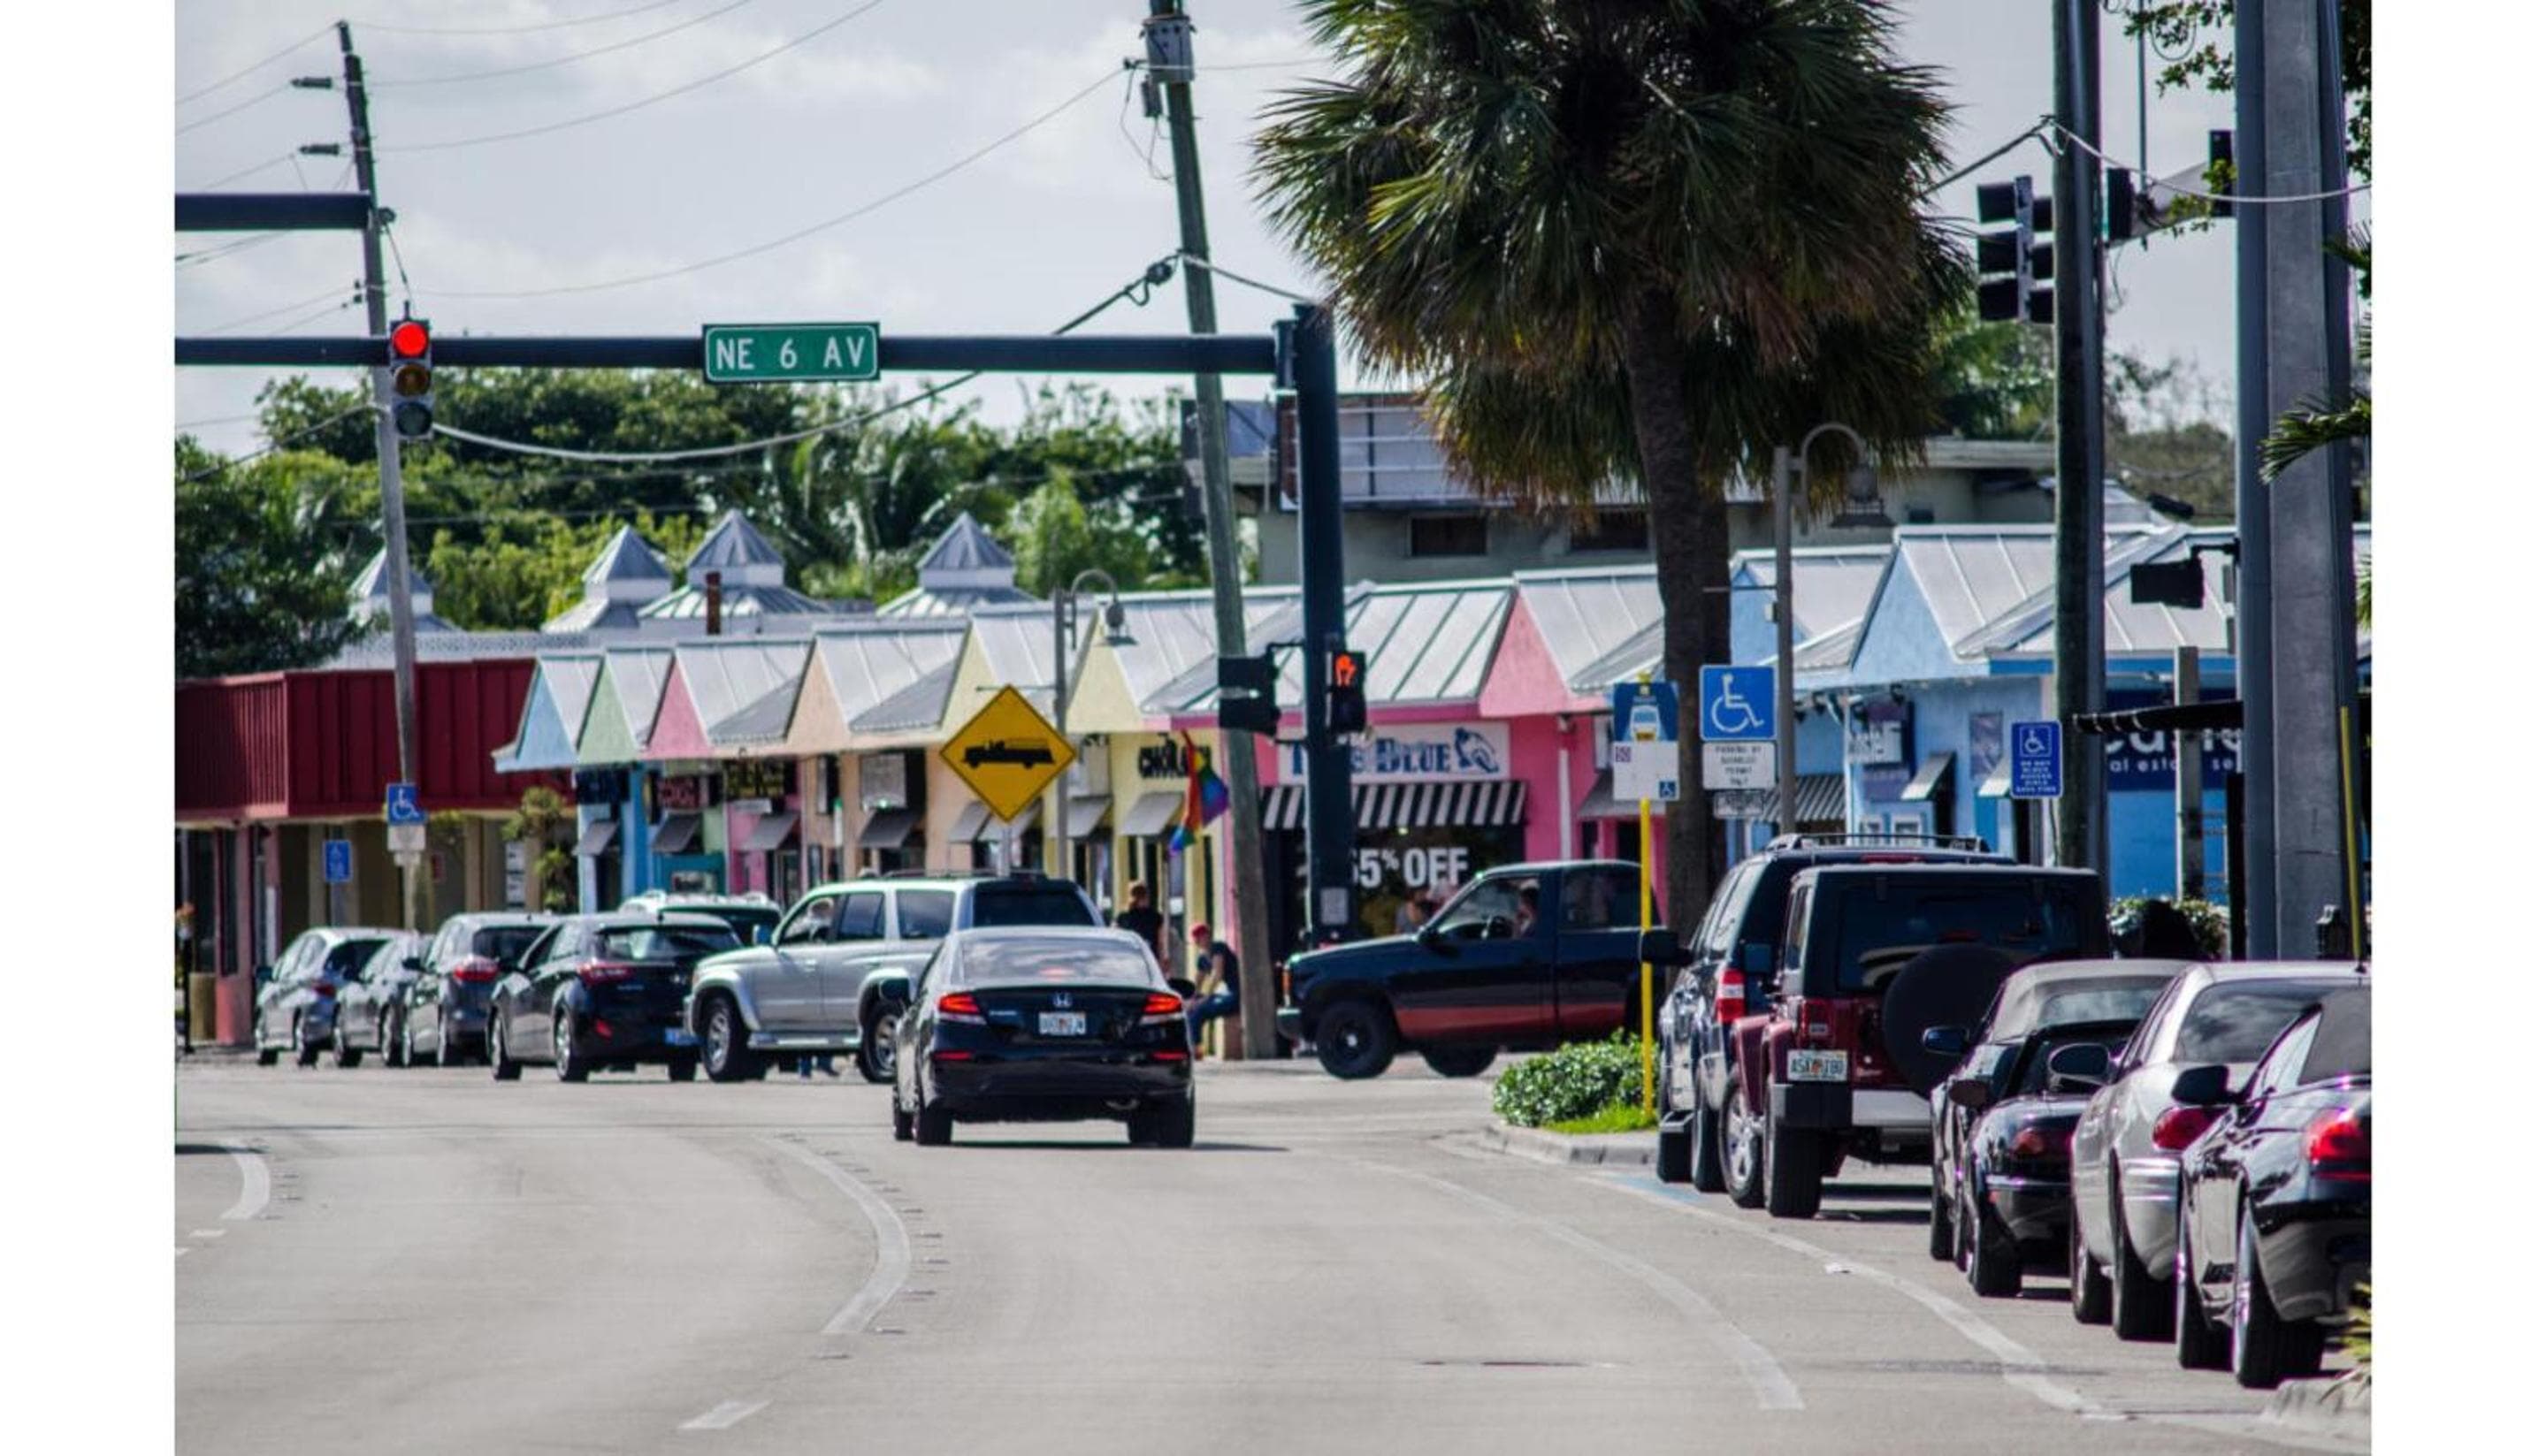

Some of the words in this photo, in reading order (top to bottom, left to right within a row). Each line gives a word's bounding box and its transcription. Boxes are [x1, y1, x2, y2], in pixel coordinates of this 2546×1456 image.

[715, 337, 755, 370] NE
[779, 337, 798, 370] 6
[822, 335, 866, 369] AV
[1376, 737, 1451, 774] BLUE
[2137, 758, 2178, 773] esta
[1403, 847, 1469, 888] OFF
